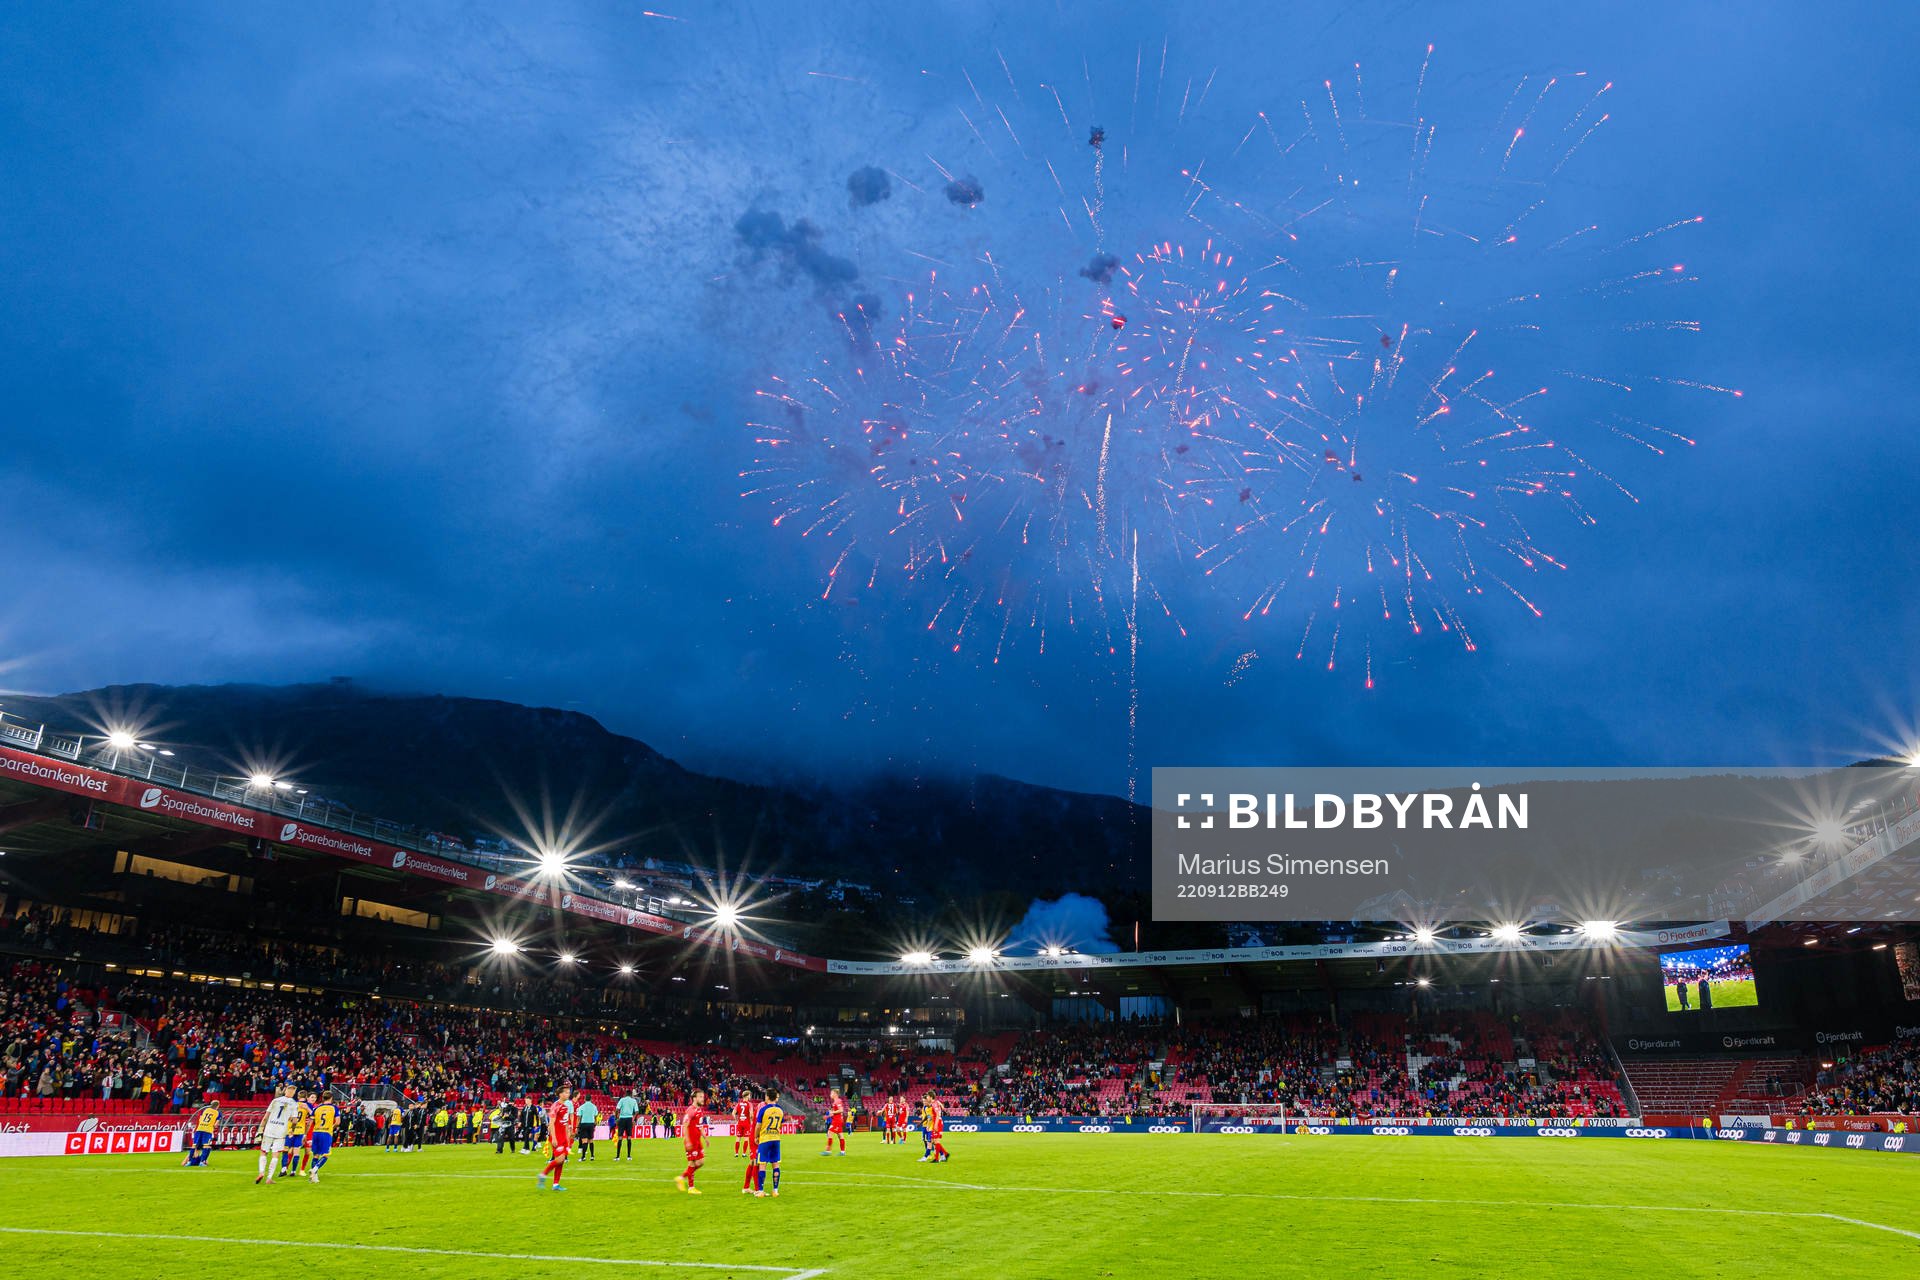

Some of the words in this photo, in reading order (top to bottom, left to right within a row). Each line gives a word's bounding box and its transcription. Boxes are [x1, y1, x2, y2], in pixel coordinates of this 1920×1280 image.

[161, 794, 255, 829] SparebankenVest
[296, 828, 373, 857] SparebankenVest
[406, 856, 469, 881] SparebankenVest
[1670, 927, 1708, 942] Fjordkraft
[1734, 1036, 1776, 1047] Fjordkraft
[1825, 1031, 1863, 1043] Fjordkraft
[1640, 1039, 1681, 1050] Fjordkraft
[277, 1105, 285, 1119] 1
[740, 1106, 746, 1117] 2
[320, 1113, 326, 1127] 5
[766, 1116, 780, 1130] 27
[1431, 1118, 1459, 1126] 07000
[1588, 1118, 1618, 1127] 07000
[1625, 1128, 1667, 1139] coop
[1814, 1133, 1830, 1146] coop
[69, 1134, 169, 1151] CRAMO
[1846, 1134, 1864, 1149] coop
[1884, 1136, 1904, 1152] coop
